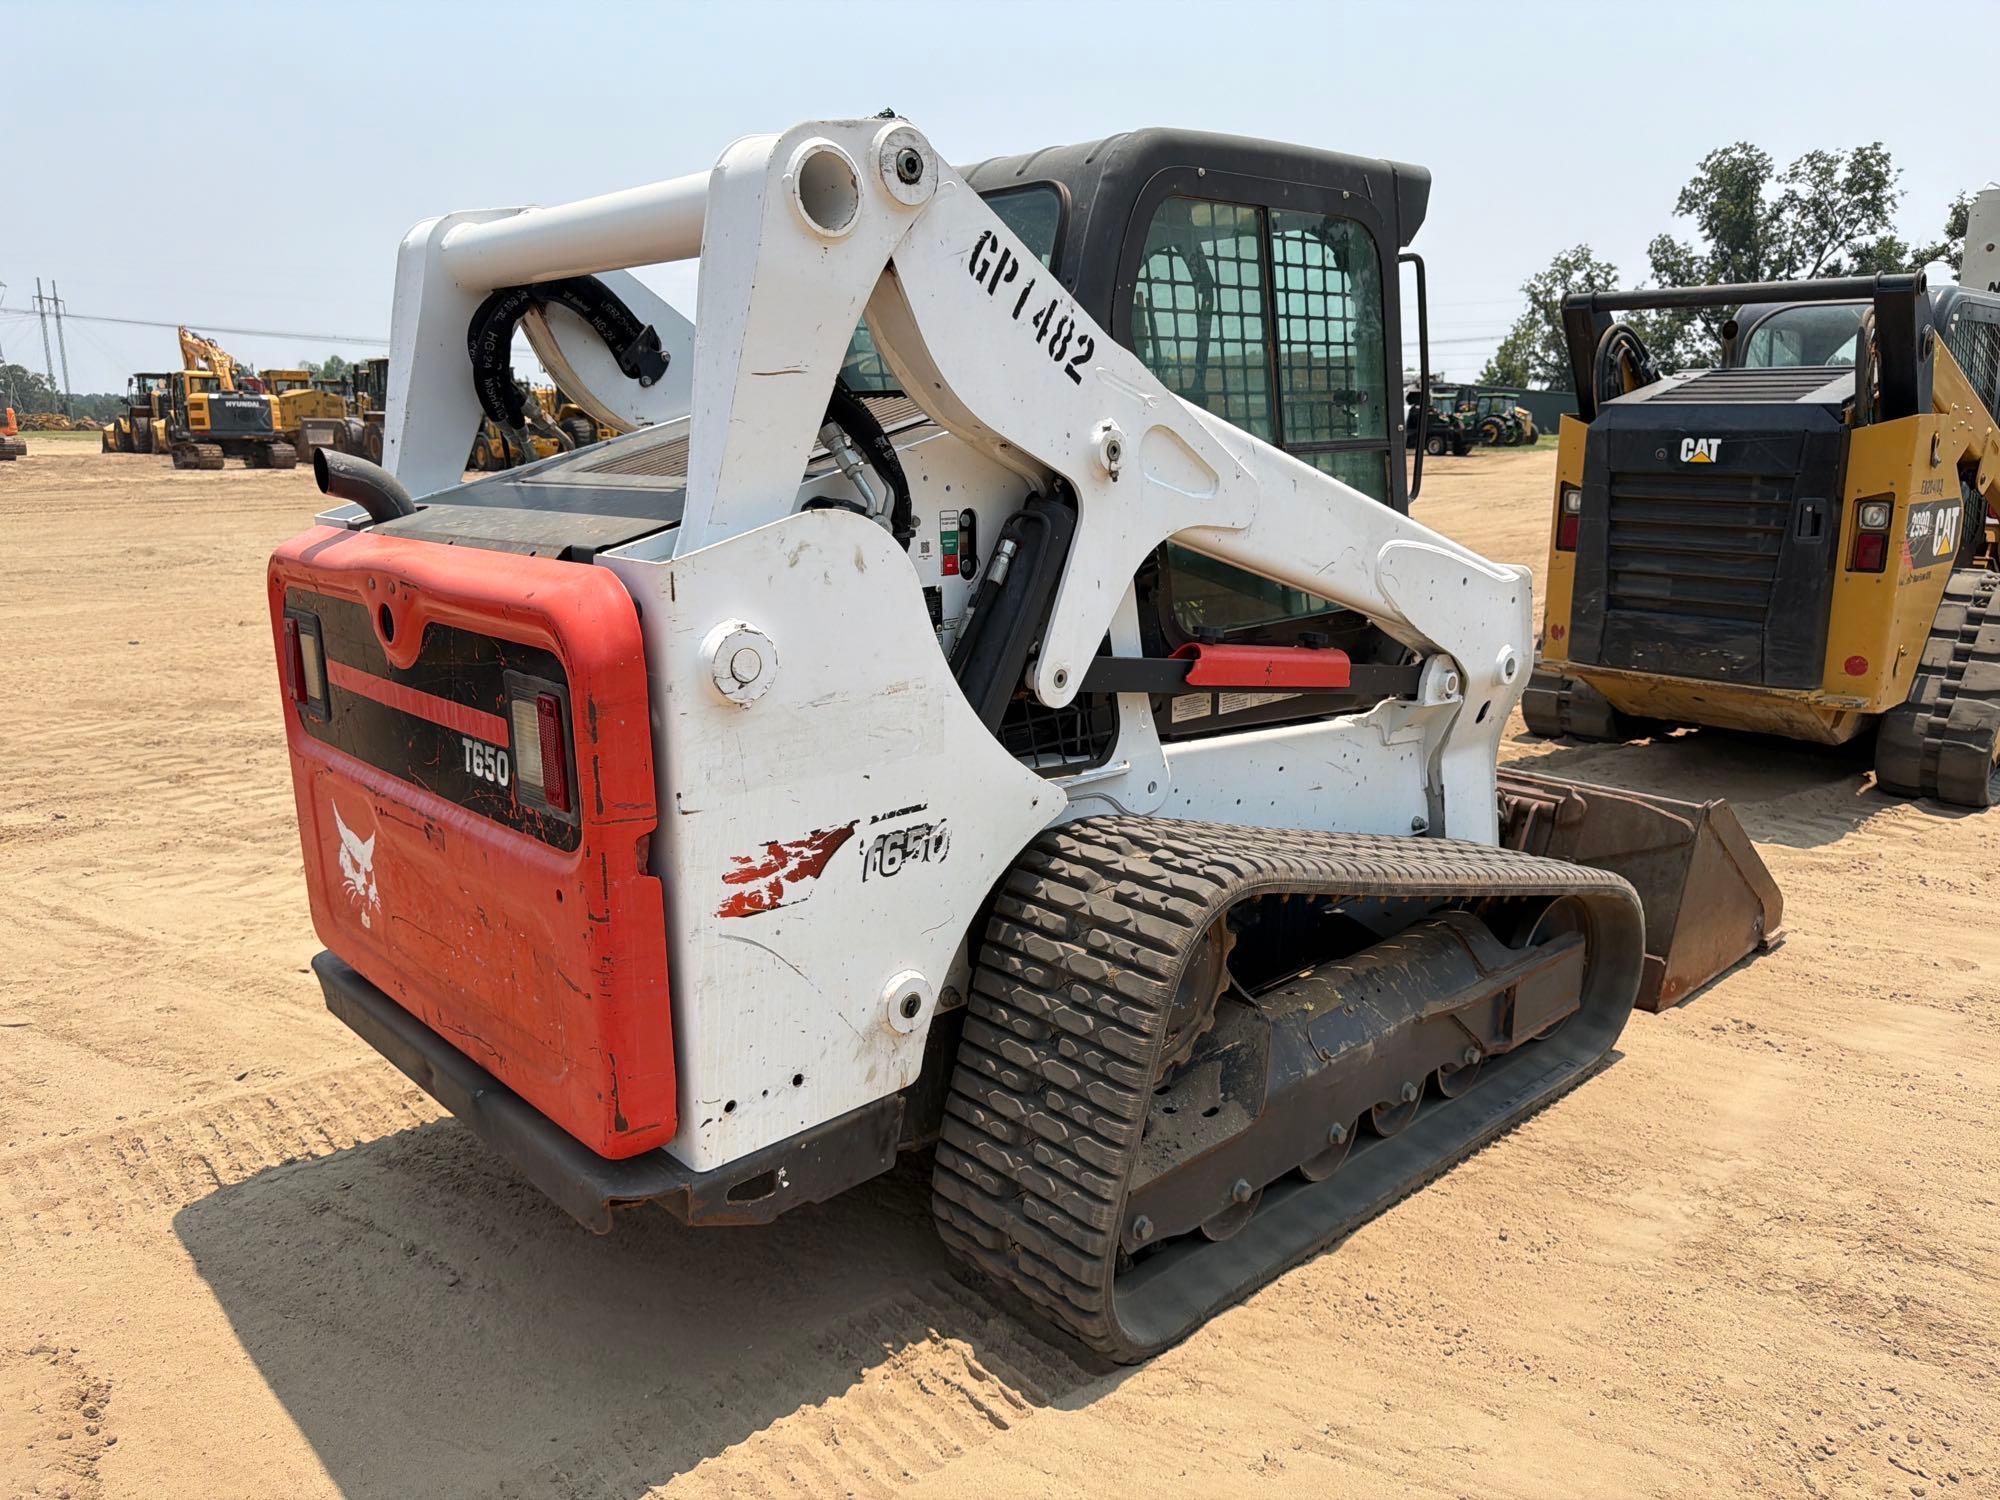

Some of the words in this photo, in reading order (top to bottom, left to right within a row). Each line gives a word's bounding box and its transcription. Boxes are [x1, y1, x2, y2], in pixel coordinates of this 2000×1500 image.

[968, 230, 1095, 385] GP1482
[1680, 437, 1722, 463] CAT
[1932, 506, 1960, 557] CAT
[462, 737, 509, 787] T650
